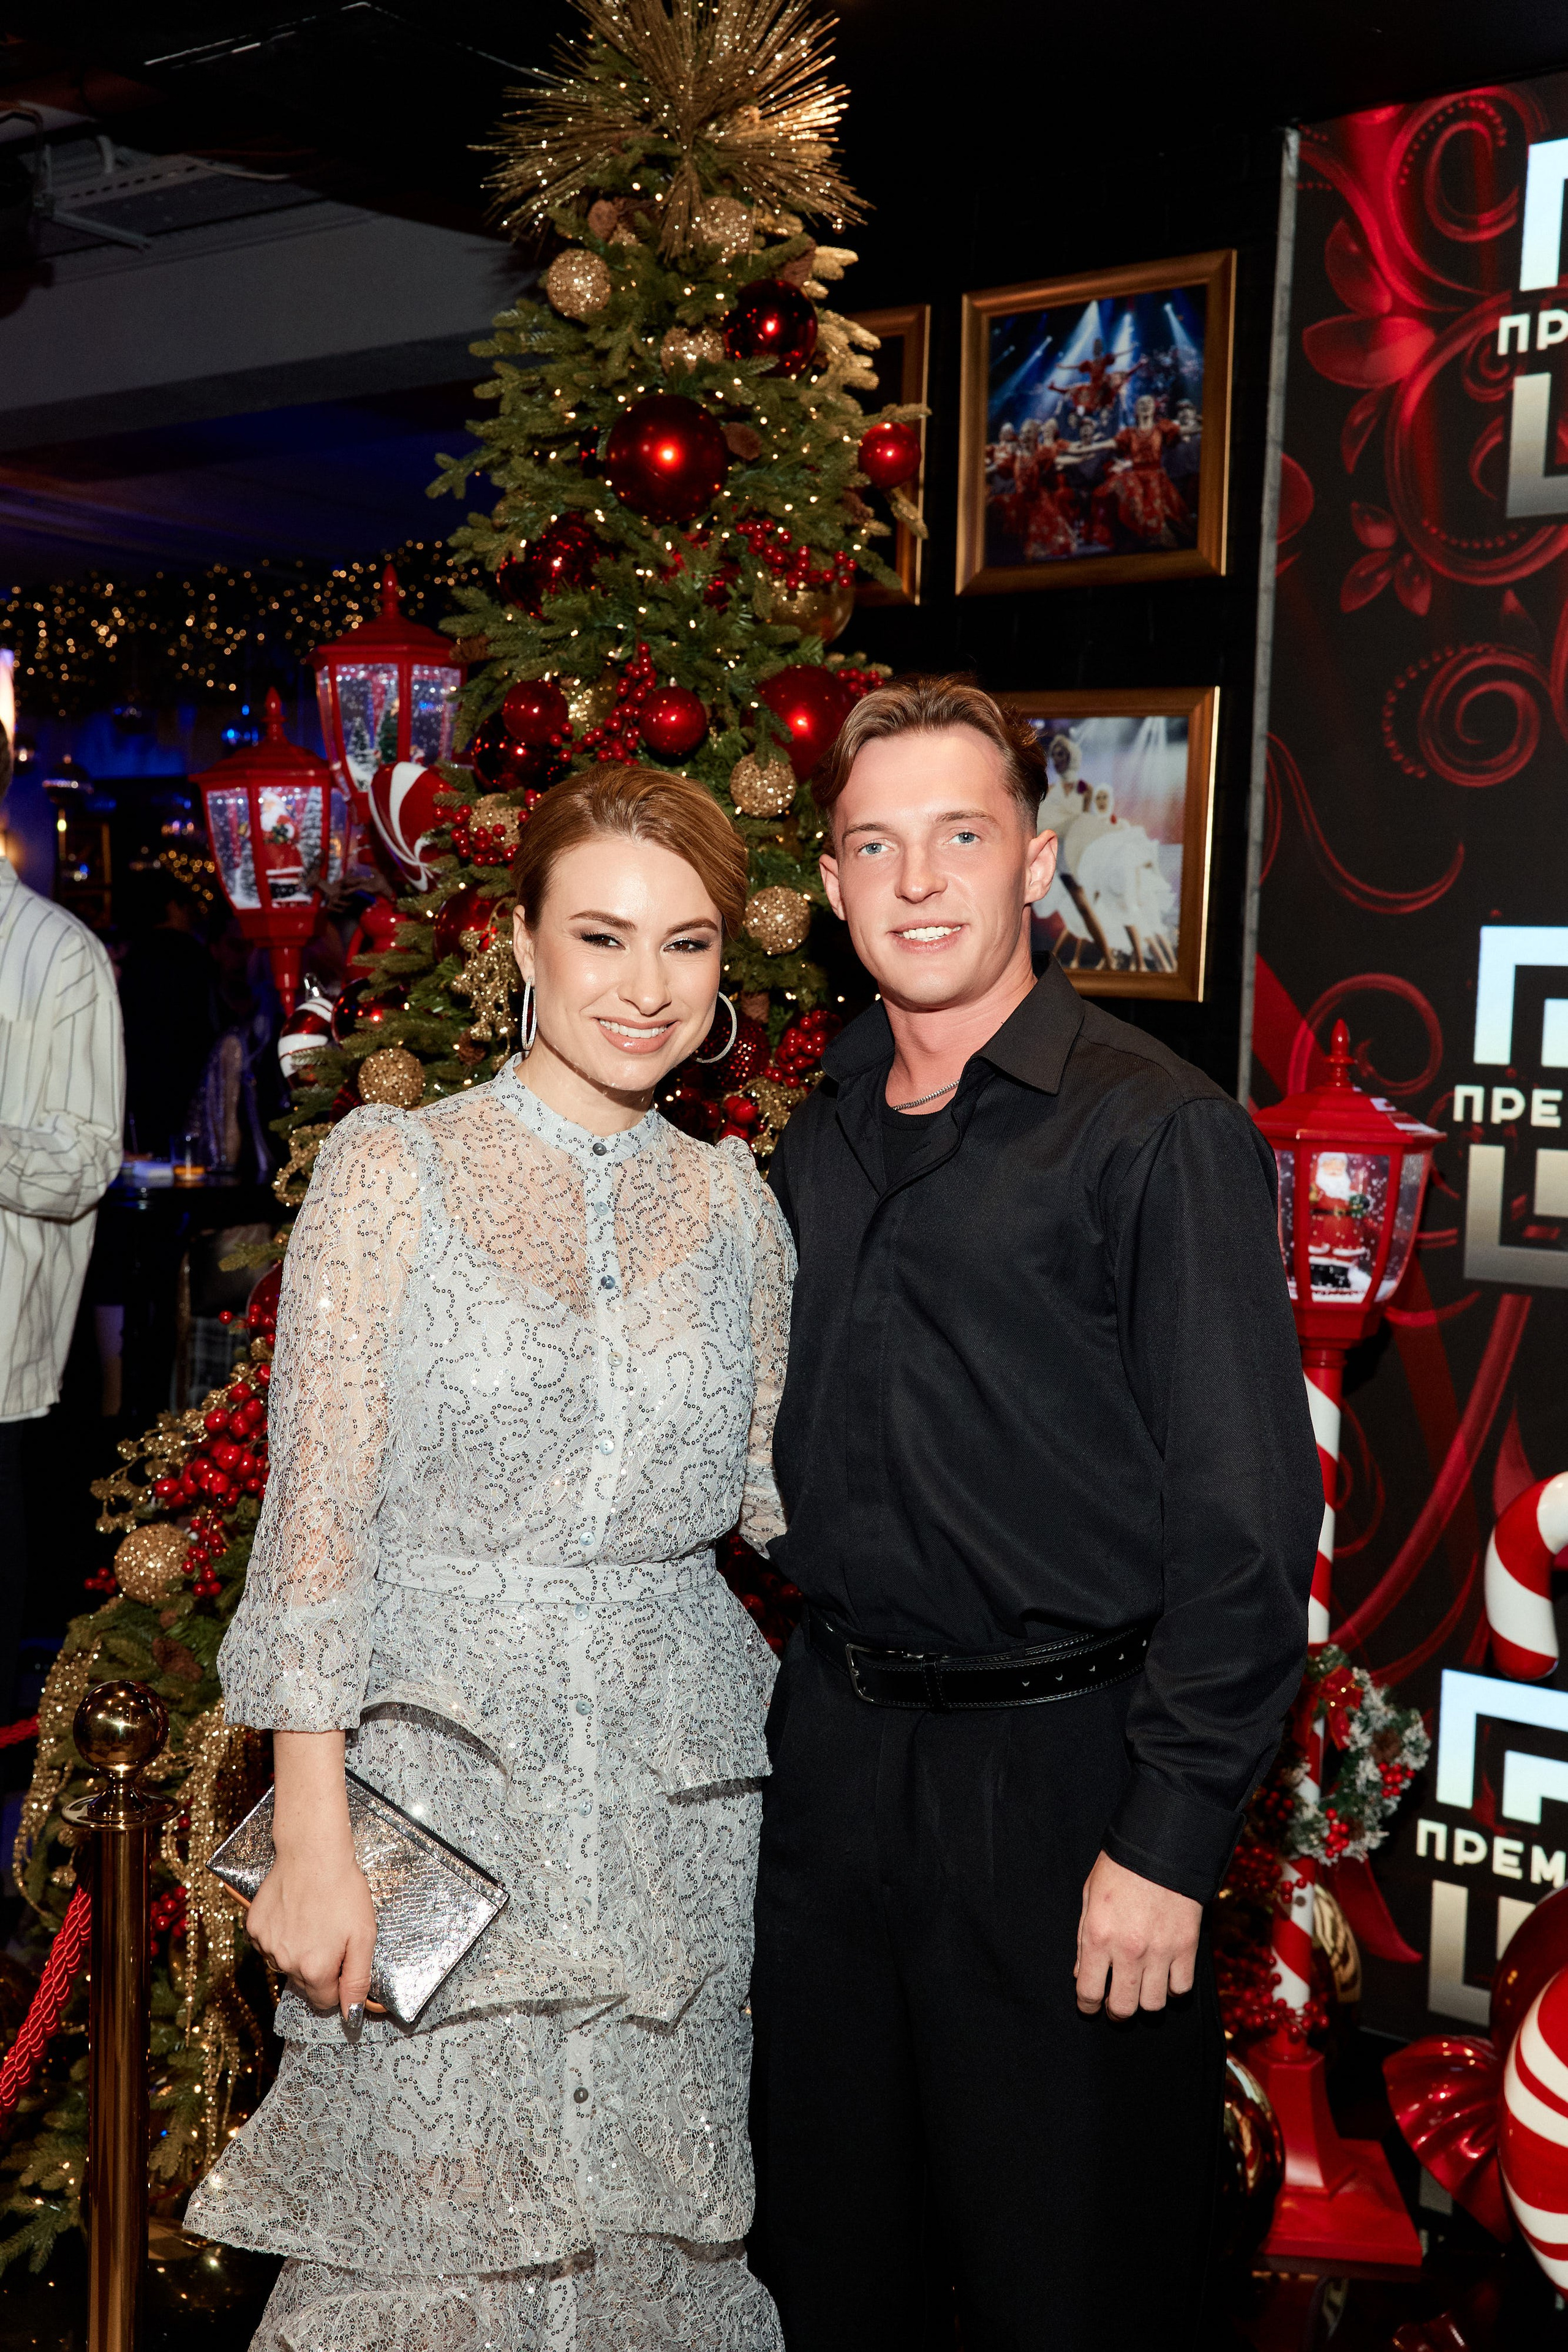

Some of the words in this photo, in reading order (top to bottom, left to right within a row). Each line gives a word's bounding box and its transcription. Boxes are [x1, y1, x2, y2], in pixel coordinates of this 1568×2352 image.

[1498, 309, 1568, 356] ПР
[1453, 1084, 1563, 1128] ПРЕ
[1416, 1818, 1566, 1889] ПРЕМ
